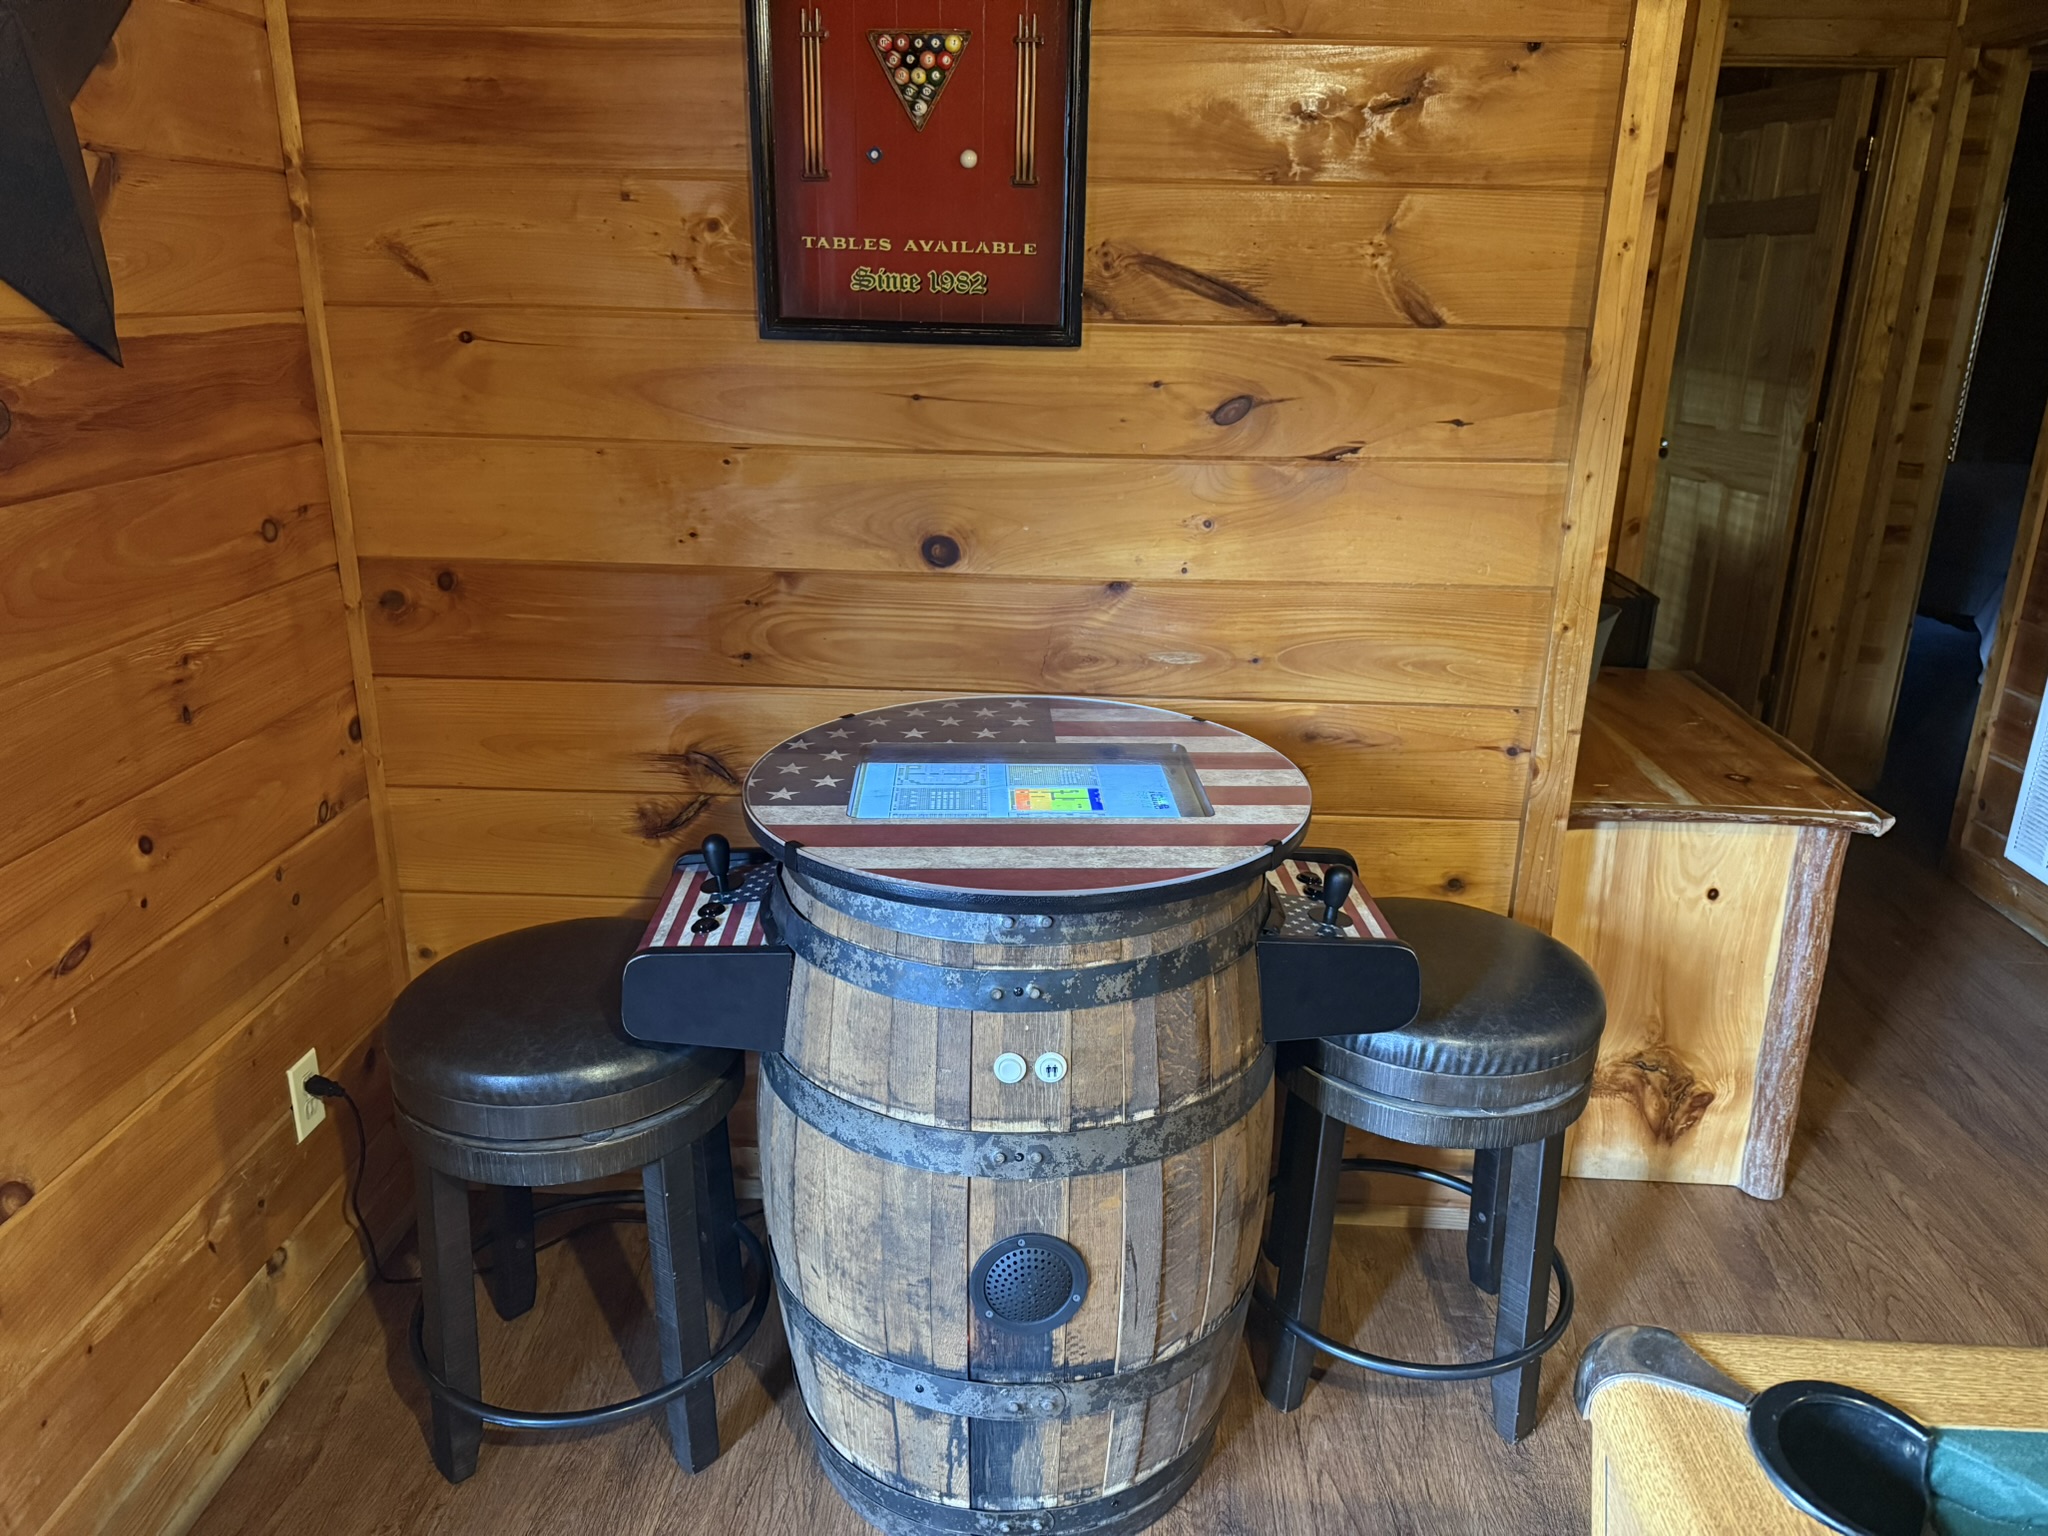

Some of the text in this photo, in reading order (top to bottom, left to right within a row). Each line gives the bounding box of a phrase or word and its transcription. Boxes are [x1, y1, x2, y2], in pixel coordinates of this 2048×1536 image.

[801, 236, 1038, 255] TABLES AVAILABLE
[850, 266, 989, 295] Since 1982
